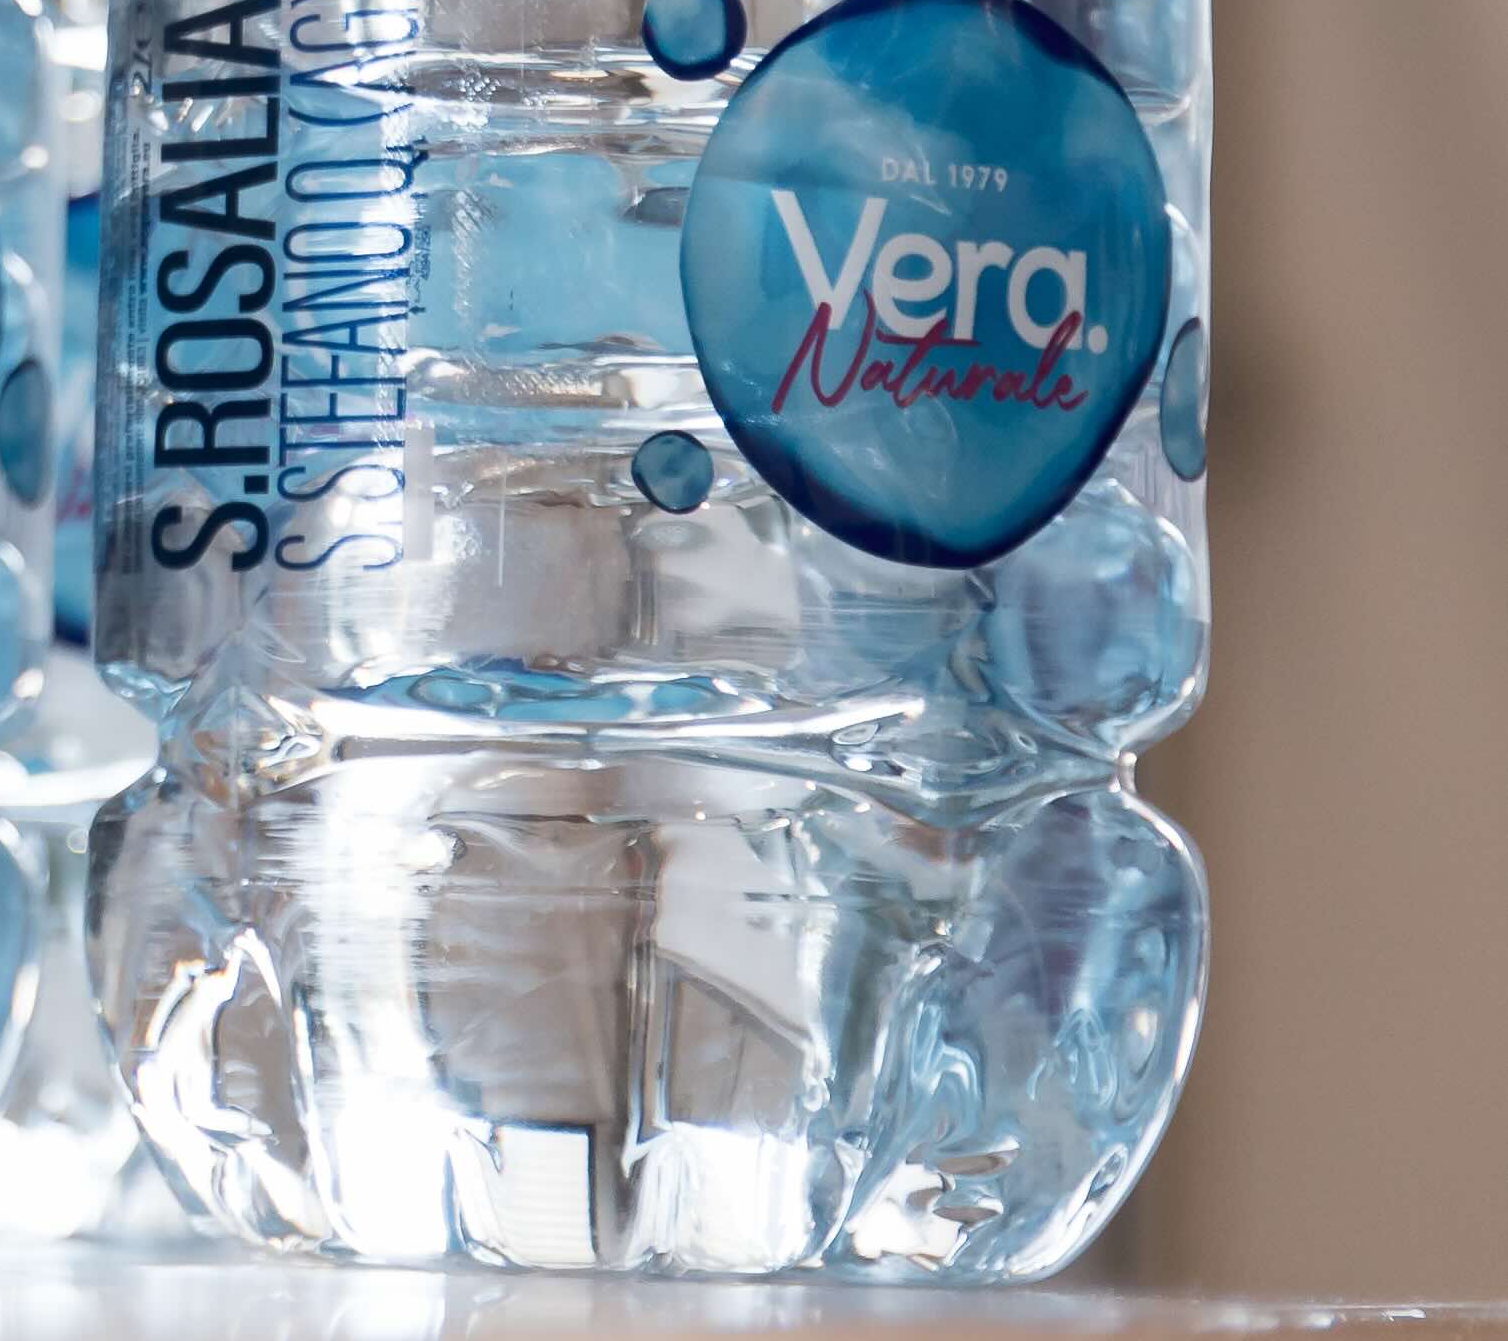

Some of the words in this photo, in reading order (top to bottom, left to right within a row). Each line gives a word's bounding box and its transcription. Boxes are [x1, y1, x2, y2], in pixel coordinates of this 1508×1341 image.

[881, 156, 936, 186] DAL
[948, 163, 1009, 193] 1979
[771, 288, 1090, 414] Naturale
